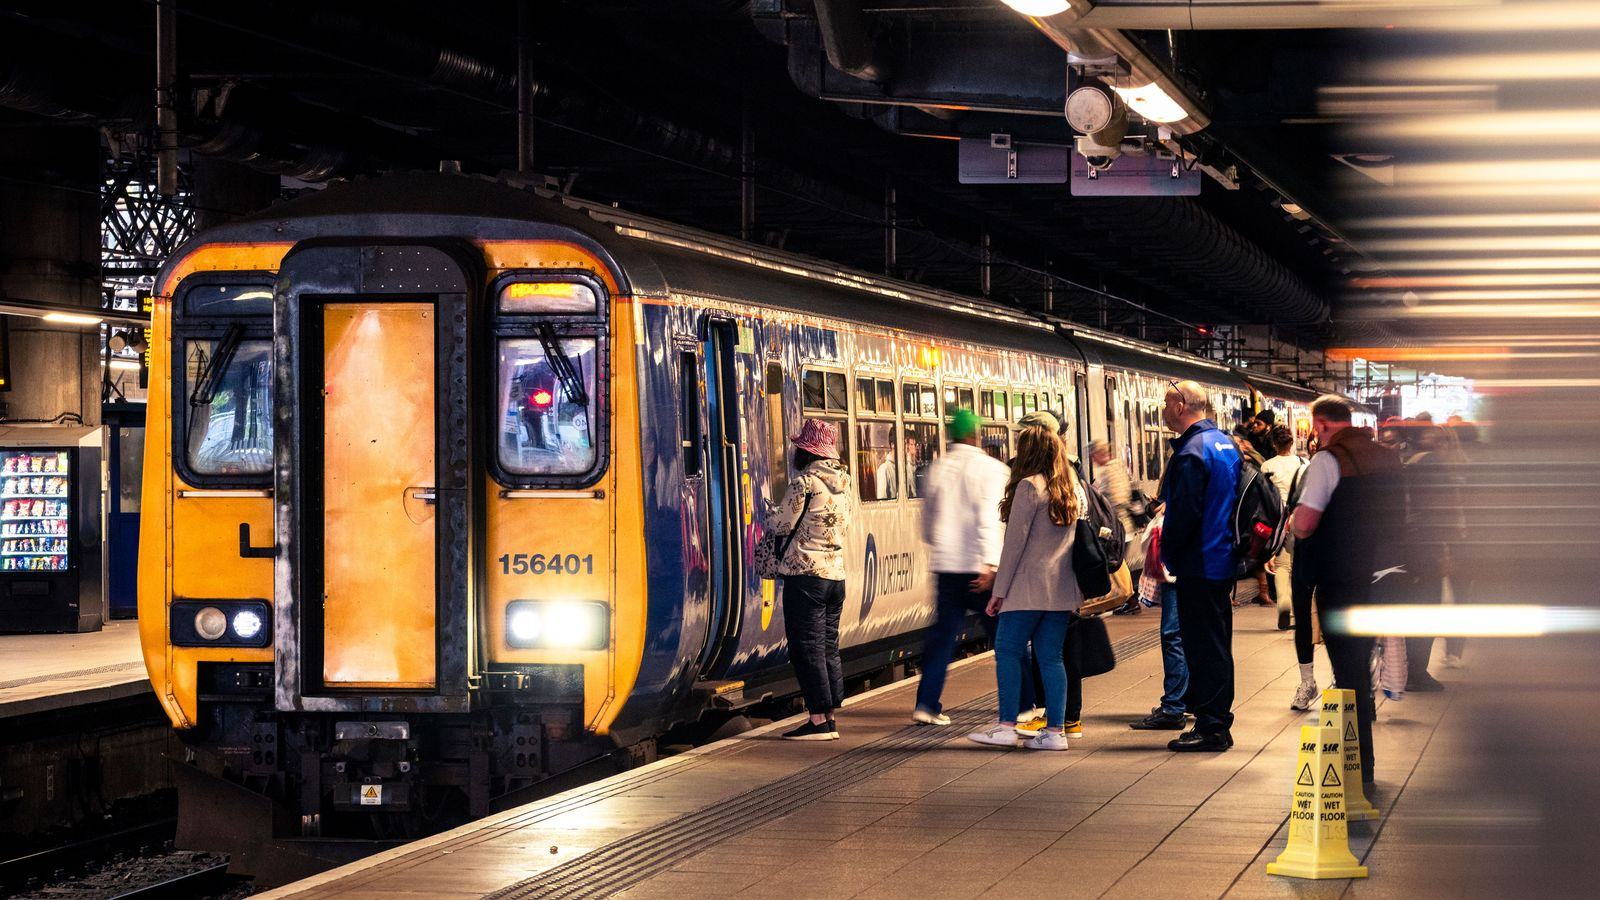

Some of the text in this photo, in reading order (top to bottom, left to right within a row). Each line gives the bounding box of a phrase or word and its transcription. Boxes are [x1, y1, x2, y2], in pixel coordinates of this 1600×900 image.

[498, 553, 593, 575] 156401
[877, 552, 915, 596] NORTHERN
[1322, 702, 1339, 711] SIR
[1344, 703, 1355, 711] SIR
[1301, 742, 1316, 752] SIR
[1322, 743, 1340, 752] SIR
[1344, 763, 1361, 771] FLOOR
[1297, 800, 1312, 809] WET
[1324, 801, 1340, 810] WET
[1292, 811, 1315, 821] FLOOR
[1320, 812, 1346, 821] FLOOR
